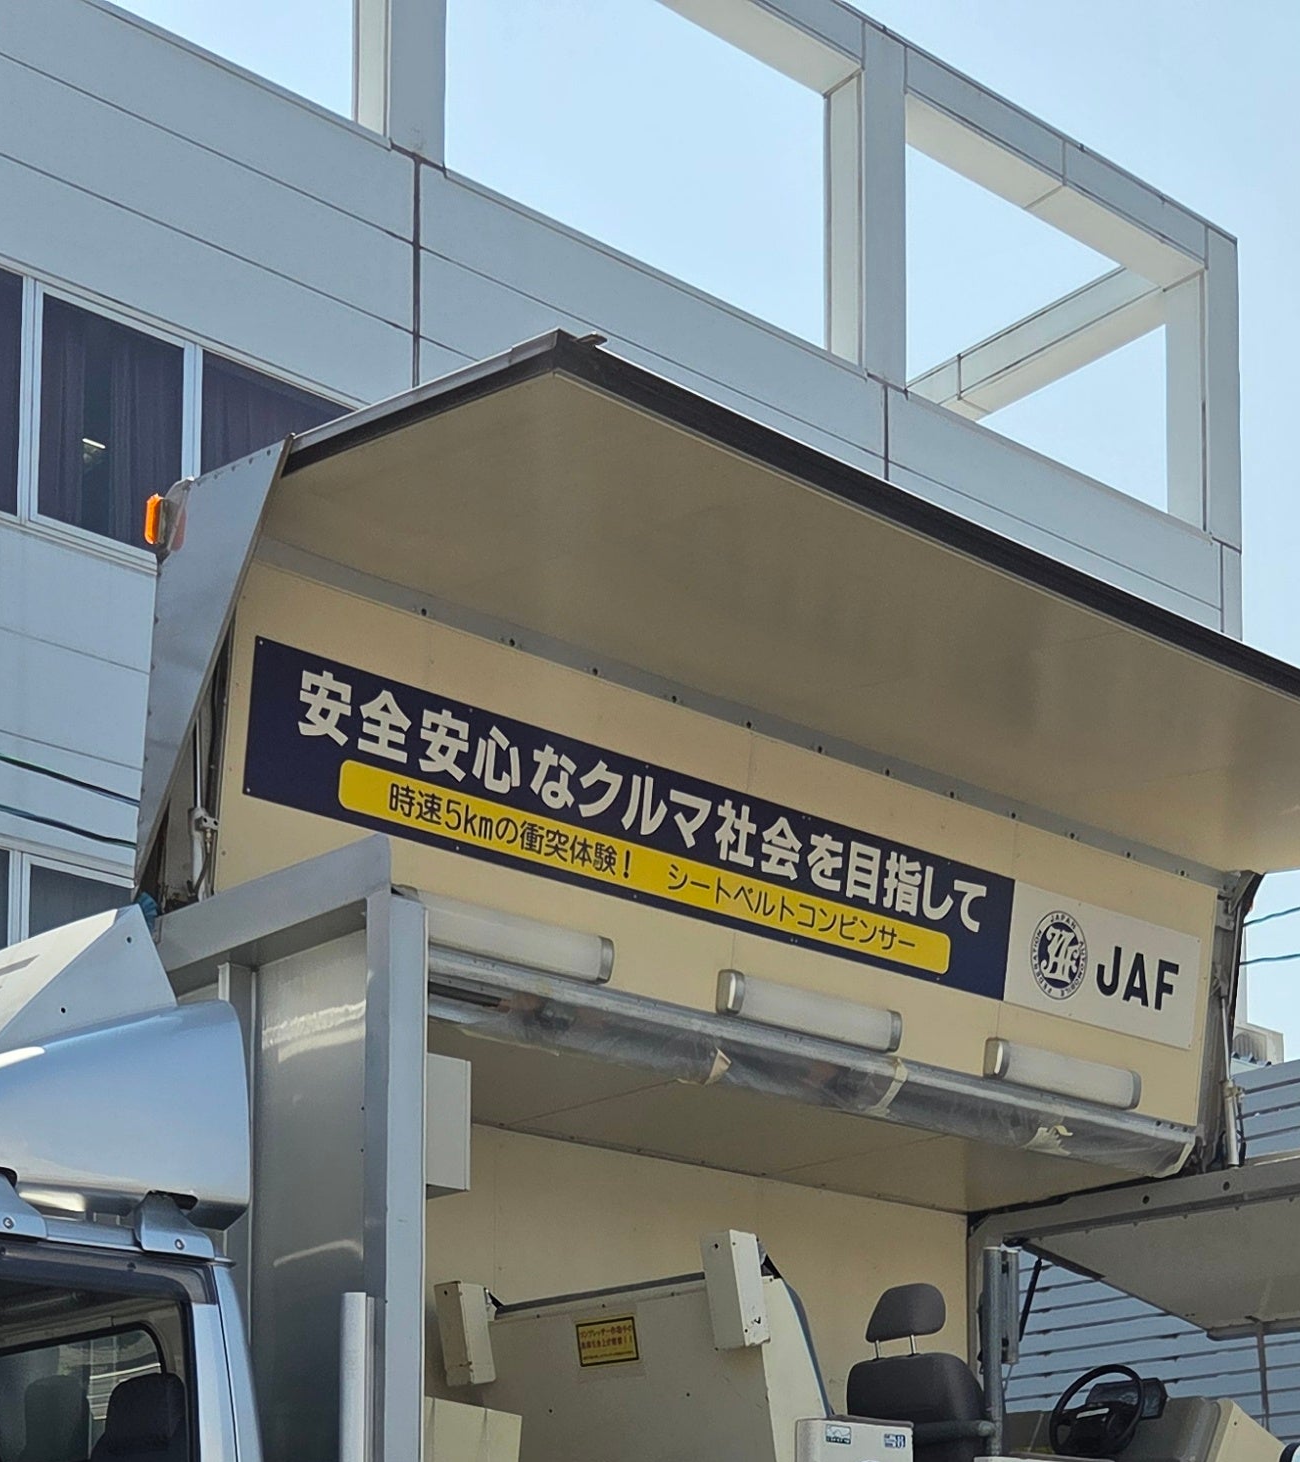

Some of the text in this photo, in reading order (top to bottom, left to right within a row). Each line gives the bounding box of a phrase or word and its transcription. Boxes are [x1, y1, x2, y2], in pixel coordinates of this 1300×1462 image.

[297, 669, 989, 933] 安全安心なクルマ社会を目指して
[387, 782, 917, 953] 時速5kmの衝突体験！ シートベルトコンビンサー
[1096, 945, 1180, 1011] JAF
